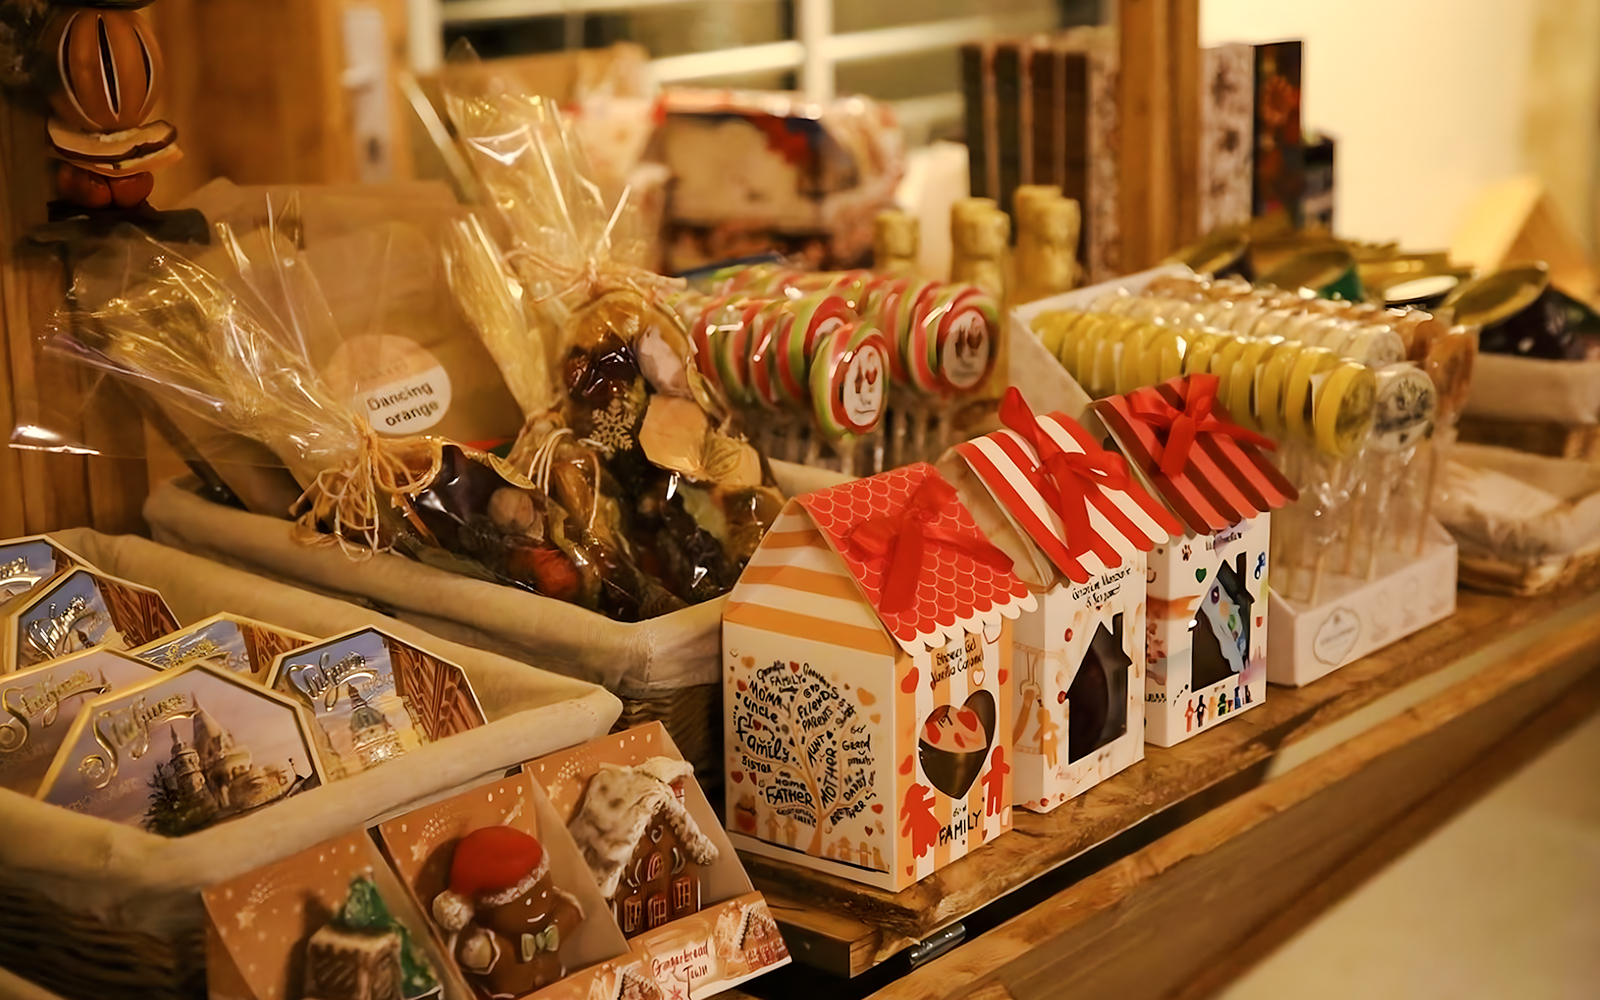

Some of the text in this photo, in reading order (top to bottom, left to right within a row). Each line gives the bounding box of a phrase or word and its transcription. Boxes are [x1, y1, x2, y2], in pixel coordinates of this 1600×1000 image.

[366, 382, 435, 411] Dancing
[385, 401, 439, 427] orange
[807, 734, 825, 767] AUNT
[939, 809, 981, 846] FAMILY
